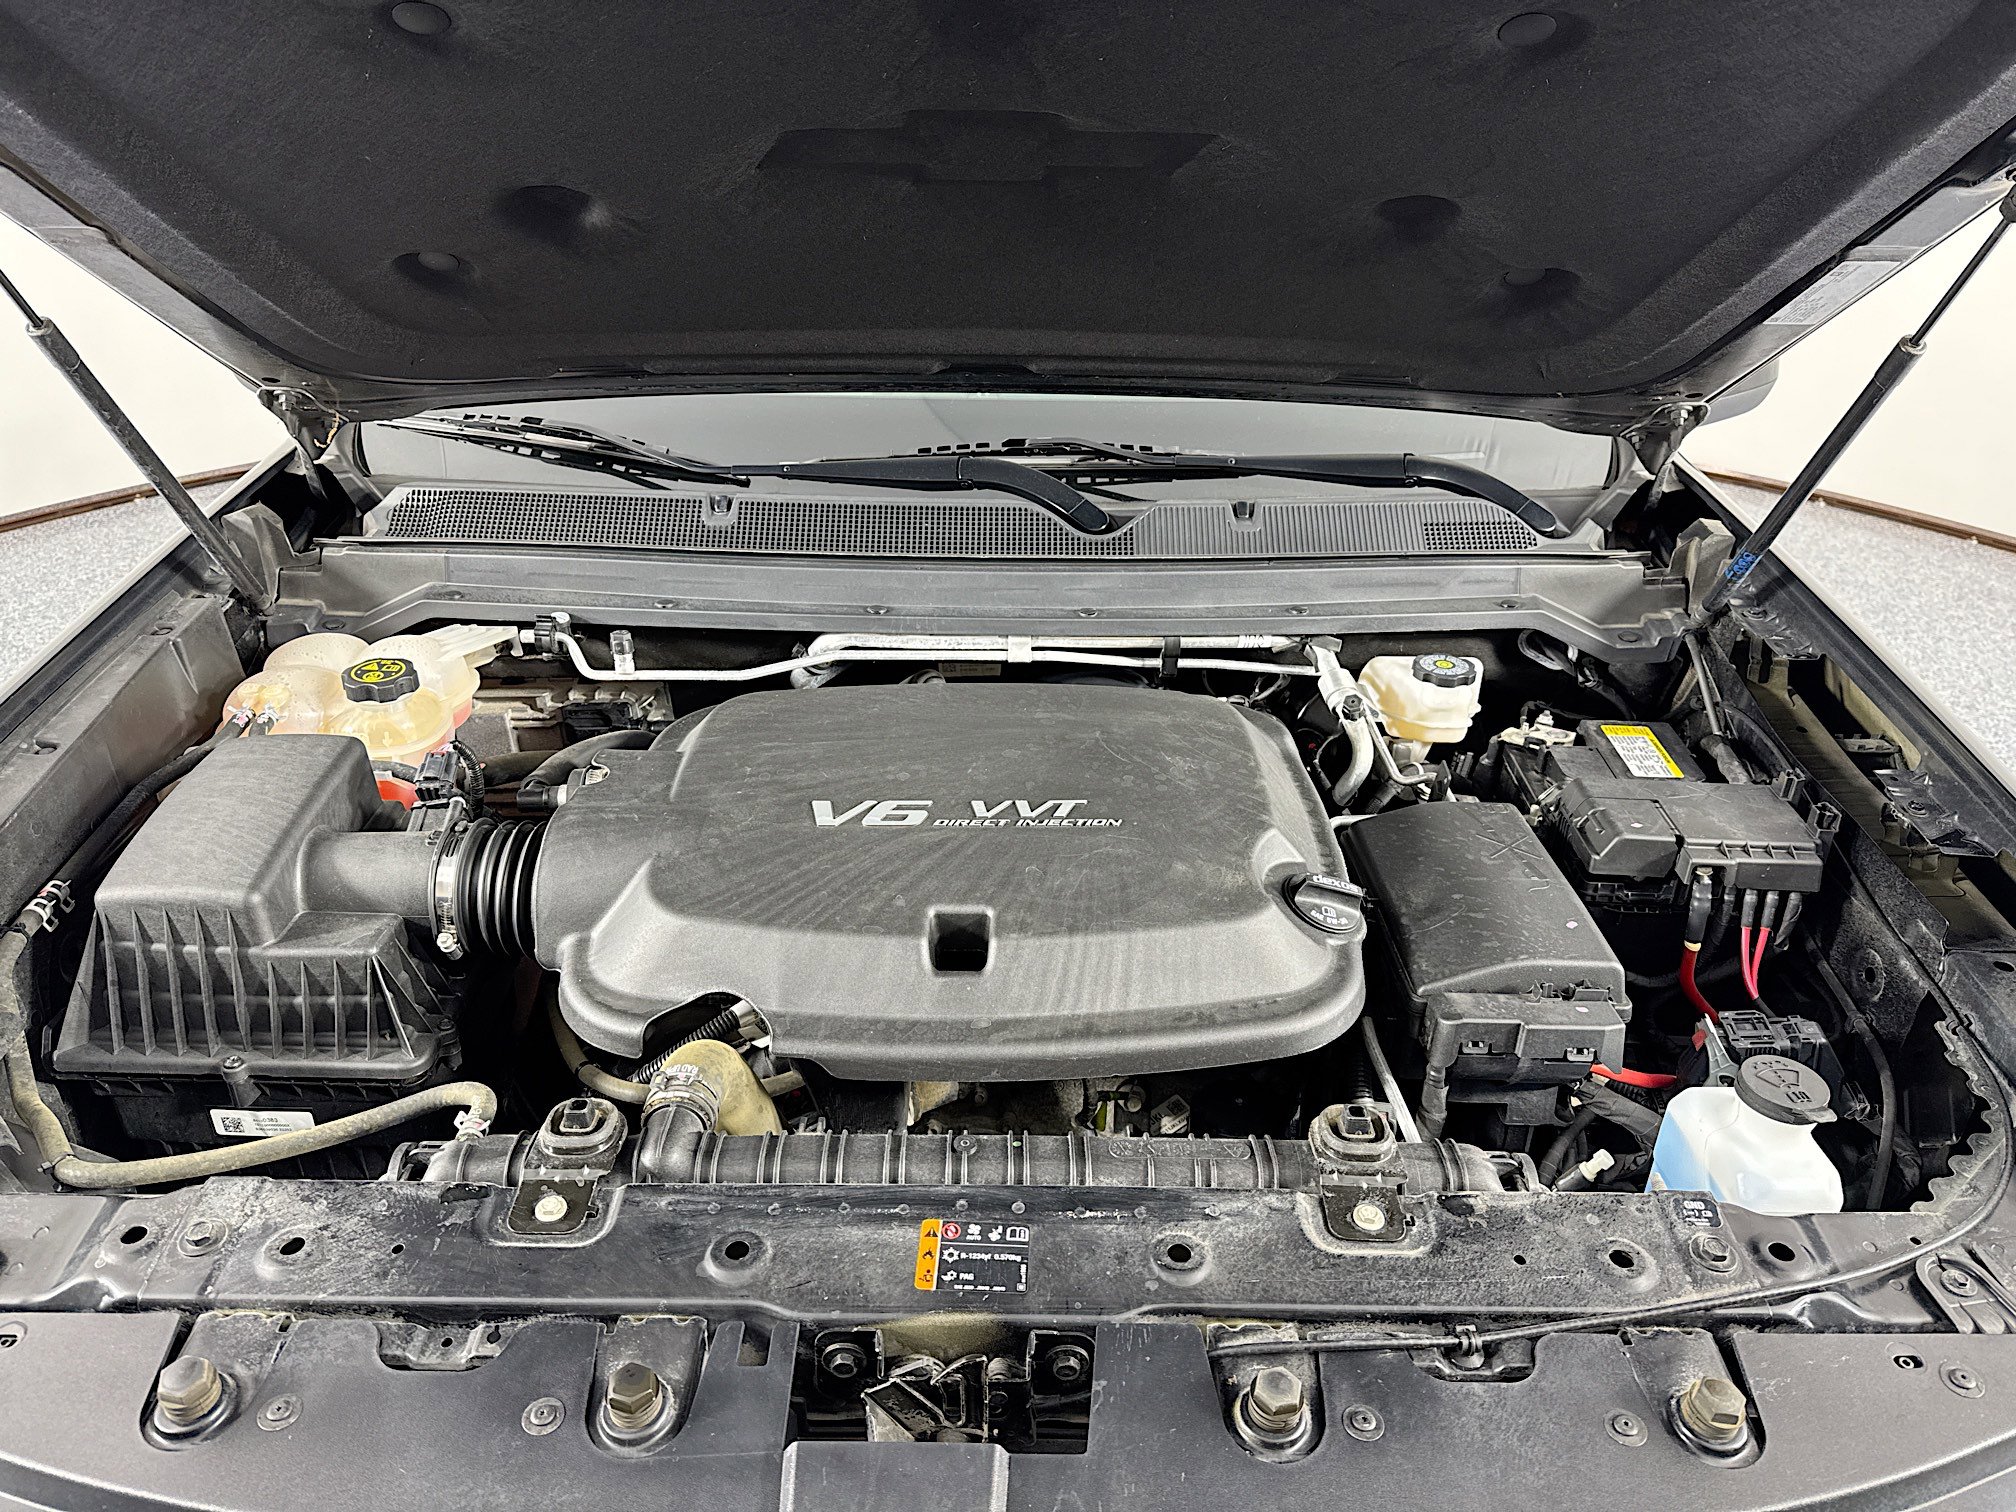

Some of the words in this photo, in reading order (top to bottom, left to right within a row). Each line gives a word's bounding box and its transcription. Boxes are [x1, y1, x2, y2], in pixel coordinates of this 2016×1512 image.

[811, 800, 934, 827] V6
[970, 799, 1088, 818] VVT
[932, 818, 1010, 827] DIRECT
[1016, 818, 1122, 827] INJECTION
[1312, 874, 1359, 892] dexos
